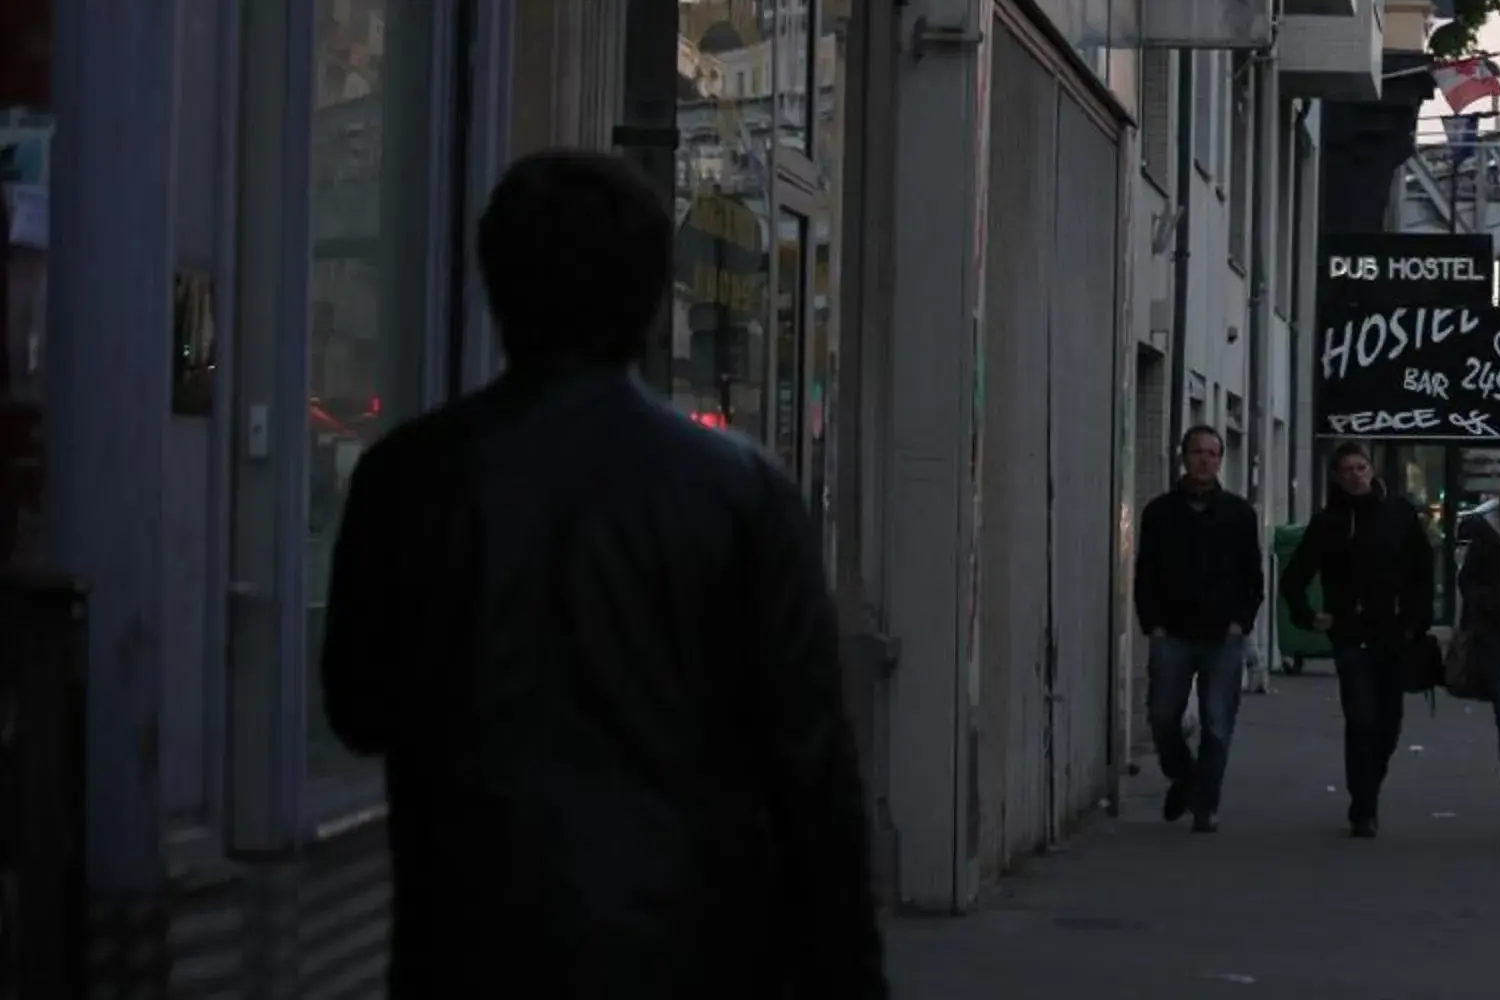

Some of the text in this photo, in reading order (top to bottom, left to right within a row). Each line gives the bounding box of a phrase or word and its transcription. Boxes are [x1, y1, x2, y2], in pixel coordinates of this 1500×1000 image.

[1388, 256, 1485, 281] HOSTEL
[1402, 365, 1449, 400] BAR
[1327, 407, 1441, 433] PEACE
